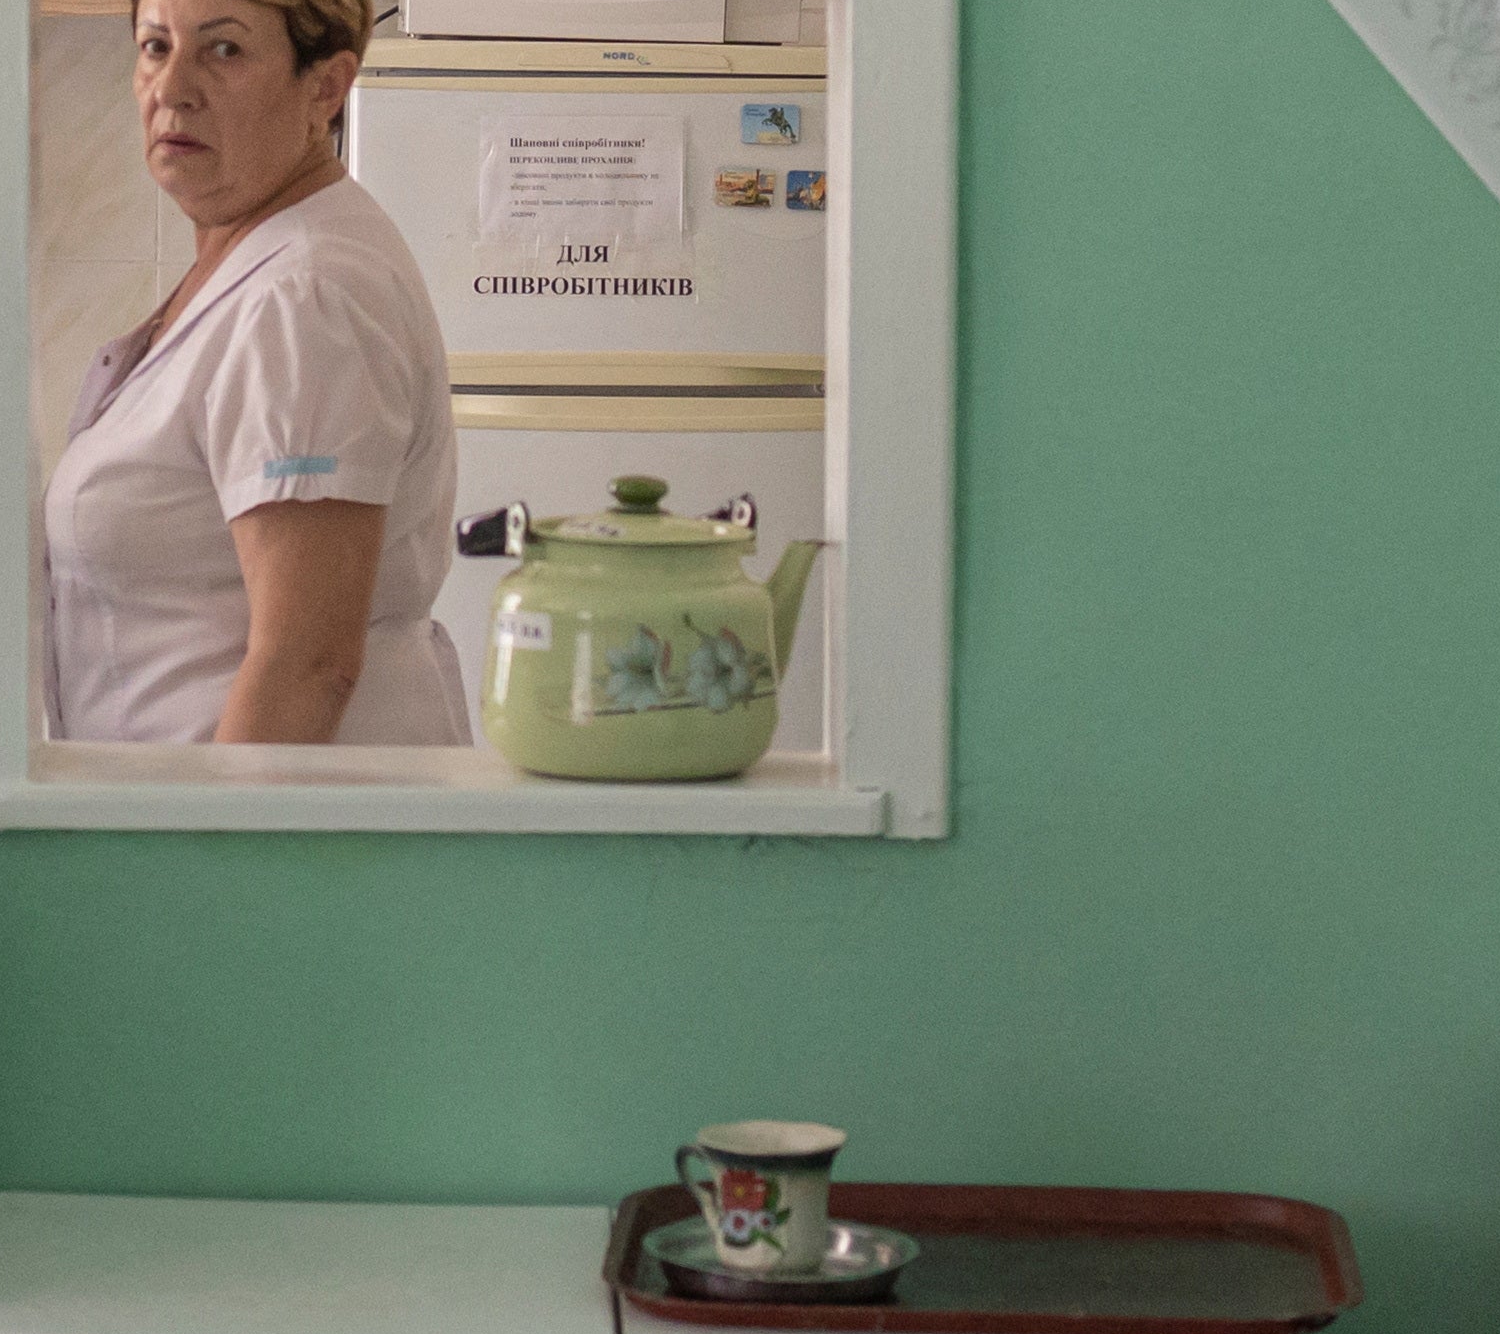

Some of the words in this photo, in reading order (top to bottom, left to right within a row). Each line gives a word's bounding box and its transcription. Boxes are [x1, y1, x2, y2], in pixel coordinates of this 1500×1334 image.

[603, 52, 635, 60] NORD
[509, 137, 560, 148] Шановні
[562, 137, 646, 150] співробітники!
[556, 244, 609, 266] ДЛЯ
[473, 275, 693, 298] СПІВРОБІТНИКІВ
